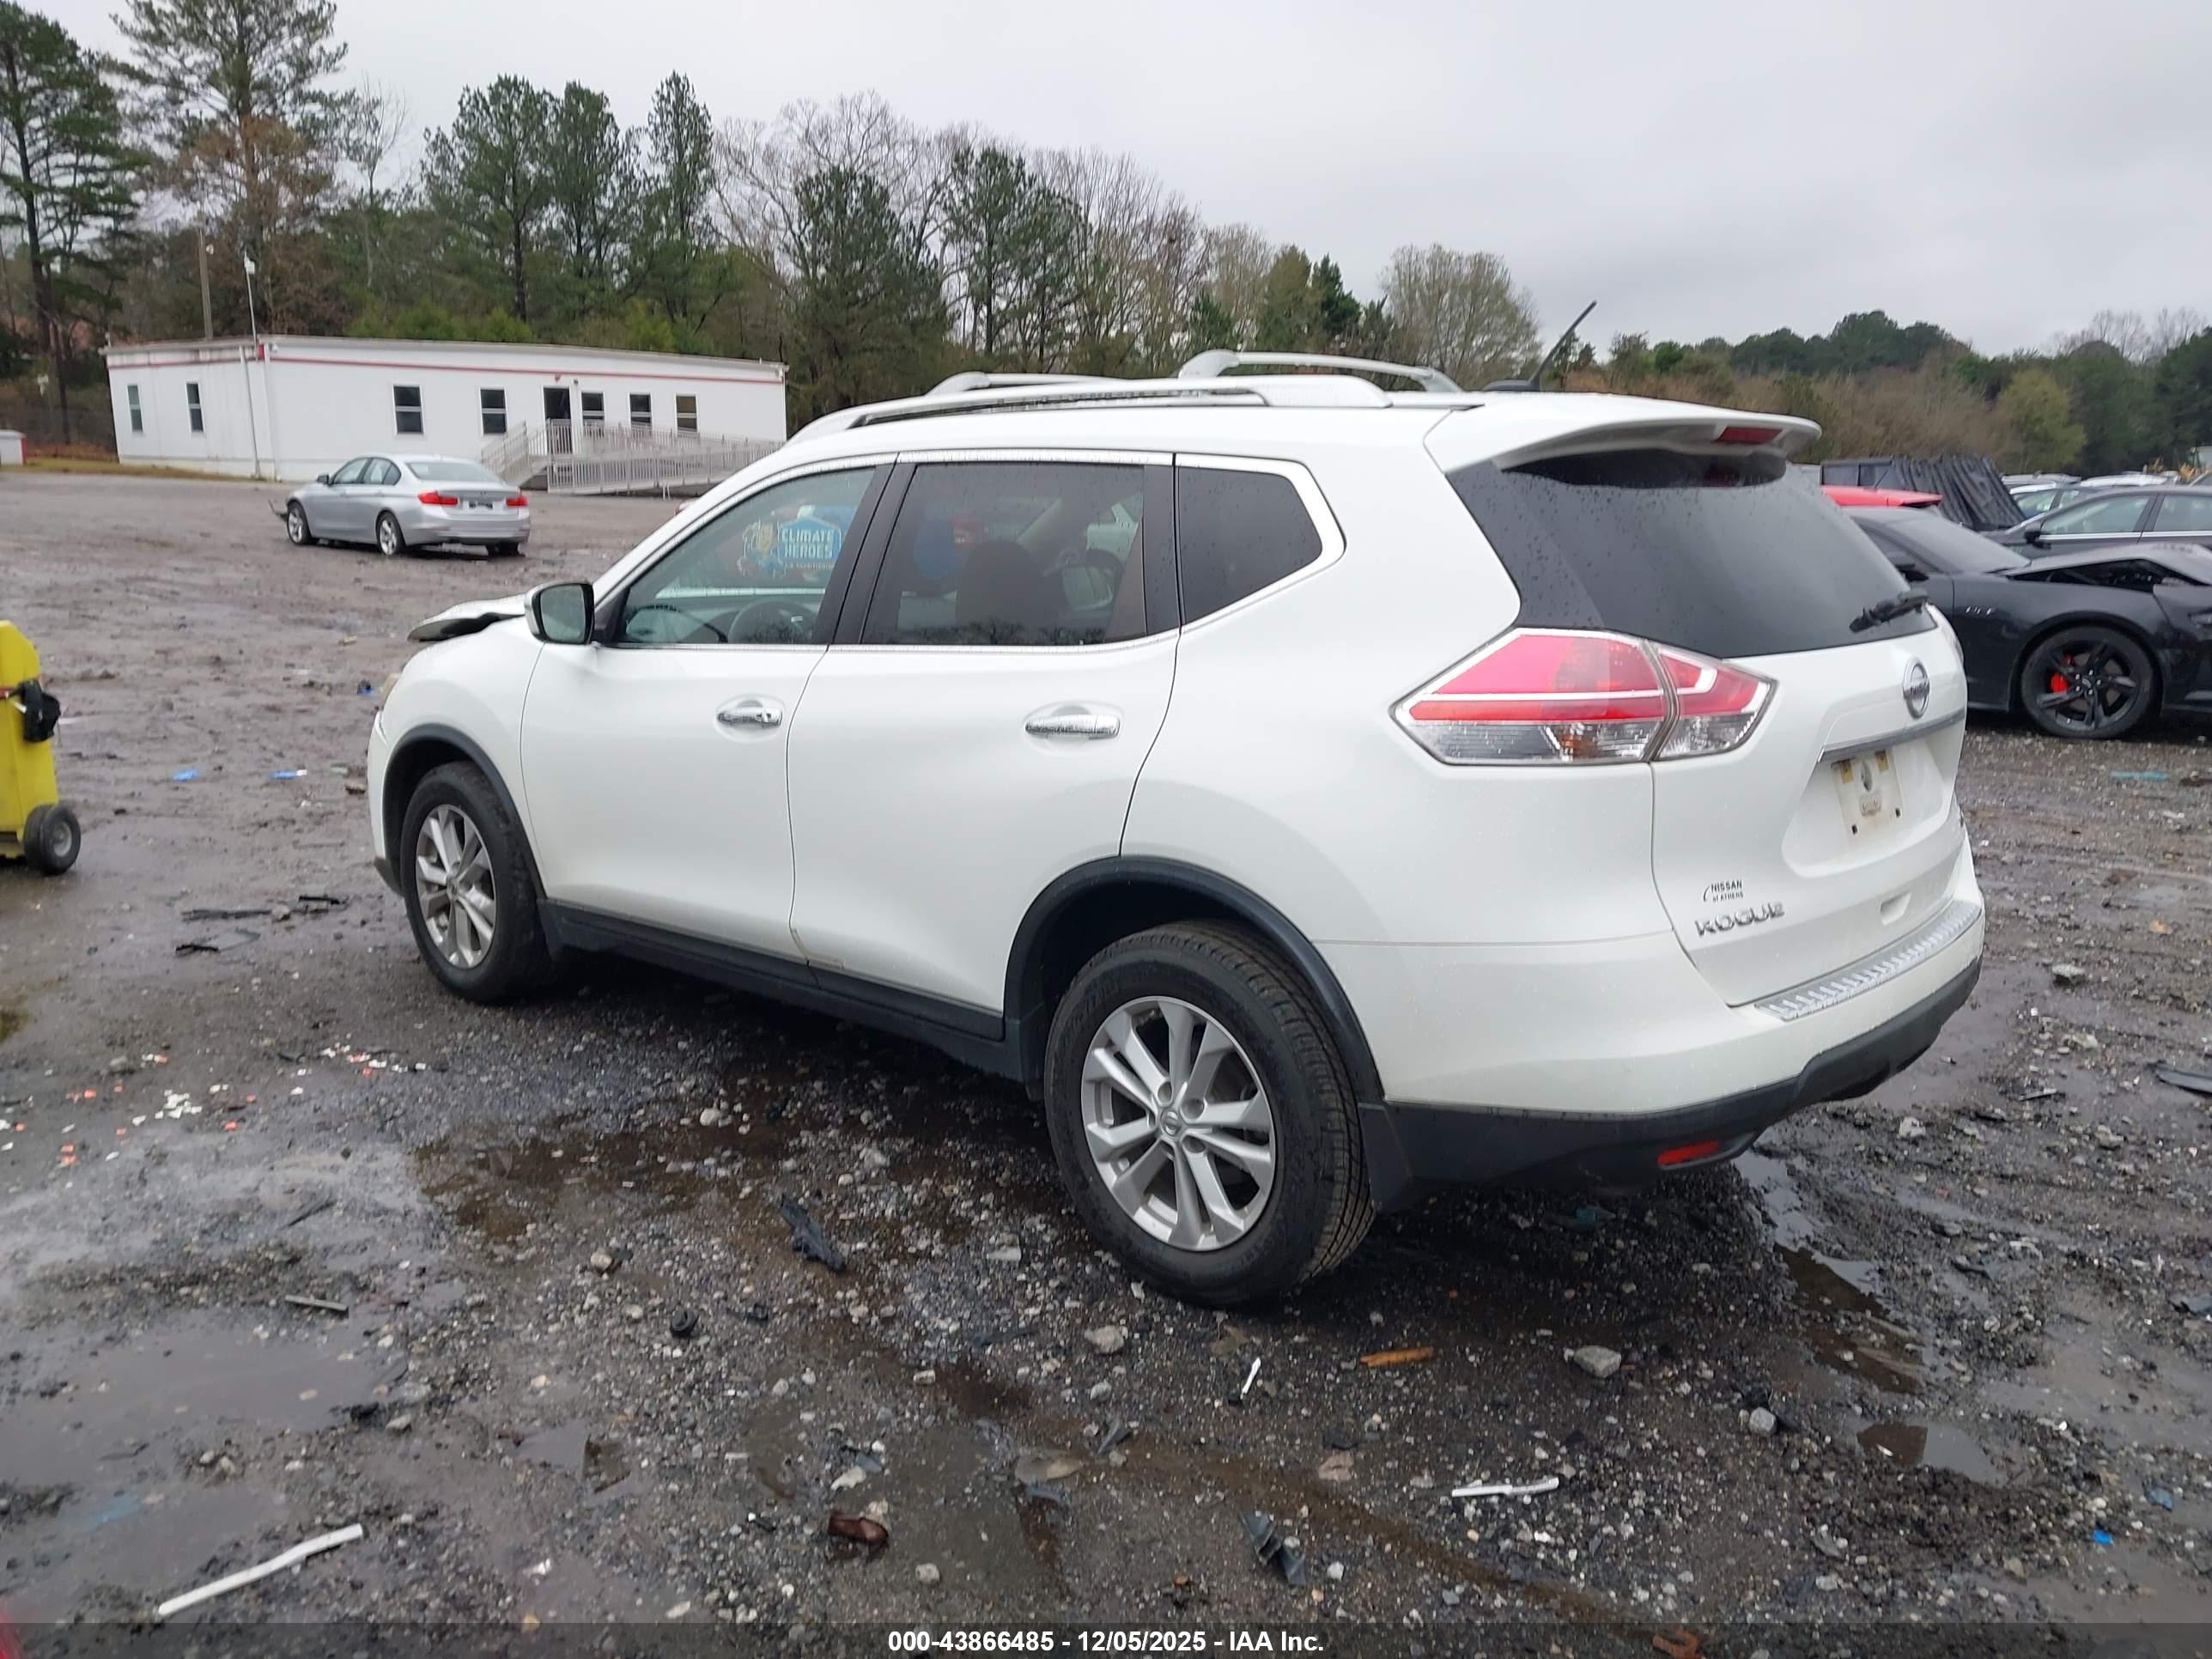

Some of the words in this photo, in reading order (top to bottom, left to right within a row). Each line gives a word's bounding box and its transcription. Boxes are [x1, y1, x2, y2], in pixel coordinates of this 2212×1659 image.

[781, 528, 834, 543] CLIMATE
[784, 543, 833, 558] HEROES
[1711, 879, 1742, 893] NISSAN
[1694, 902, 1785, 936] ROGUE
